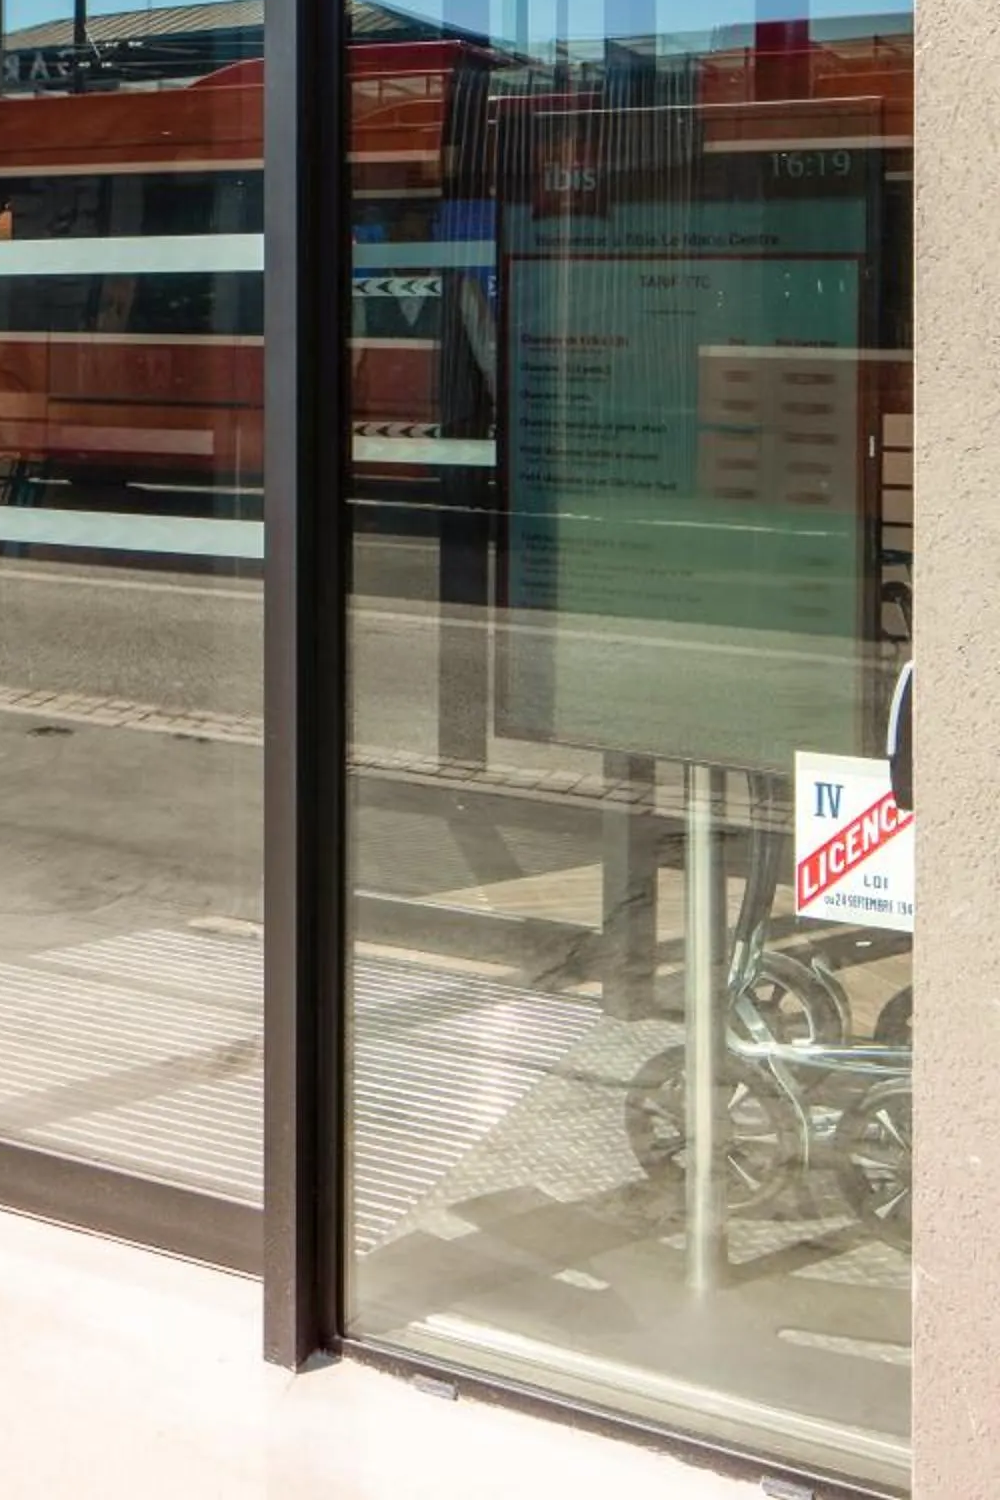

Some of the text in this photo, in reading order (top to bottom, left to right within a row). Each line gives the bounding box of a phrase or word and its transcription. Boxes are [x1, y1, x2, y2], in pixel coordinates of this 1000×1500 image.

[771, 150, 851, 178] 16:19
[814, 781, 844, 820] IV
[863, 873, 889, 890] LOI
